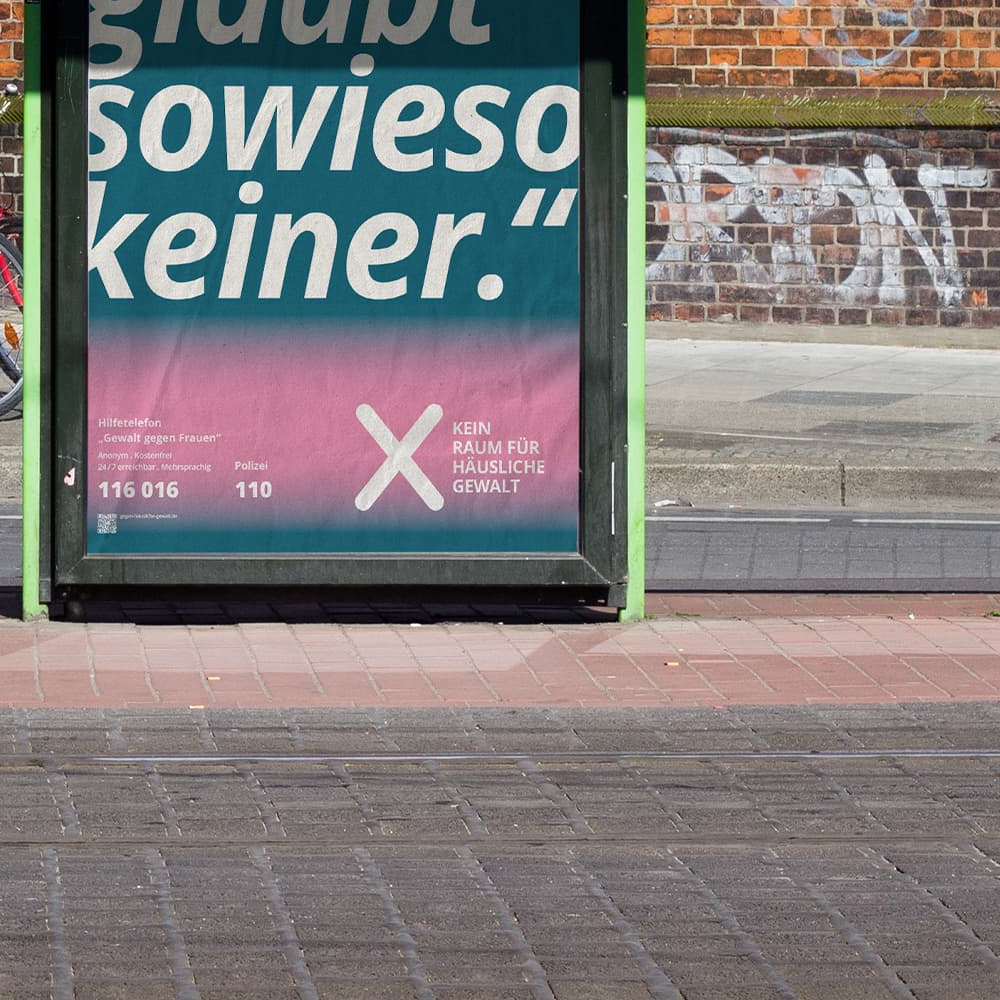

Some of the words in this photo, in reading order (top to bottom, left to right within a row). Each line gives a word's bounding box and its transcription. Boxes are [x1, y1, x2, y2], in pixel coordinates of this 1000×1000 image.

[89, 53, 580, 172] sowieso
[98, 417, 162, 429] Hilfetelefon
[452, 421, 491, 435] KEIN
[143, 434, 176, 446] gegen
[453, 440, 502, 455] RAUM
[507, 437, 540, 455] FÜR
[97, 452, 129, 461] Anonym
[134, 451, 173, 460] Kostenfrei
[117, 463, 156, 471] erreichbar
[161, 462, 212, 473] Mehrsprachig
[234, 460, 269, 471] Polizei
[453, 456, 545, 474] HÄUSLICHE
[98, 481, 136, 499] 116
[141, 481, 180, 499] 016
[235, 481, 273, 499] 110
[452, 479, 521, 493] GEWALT
